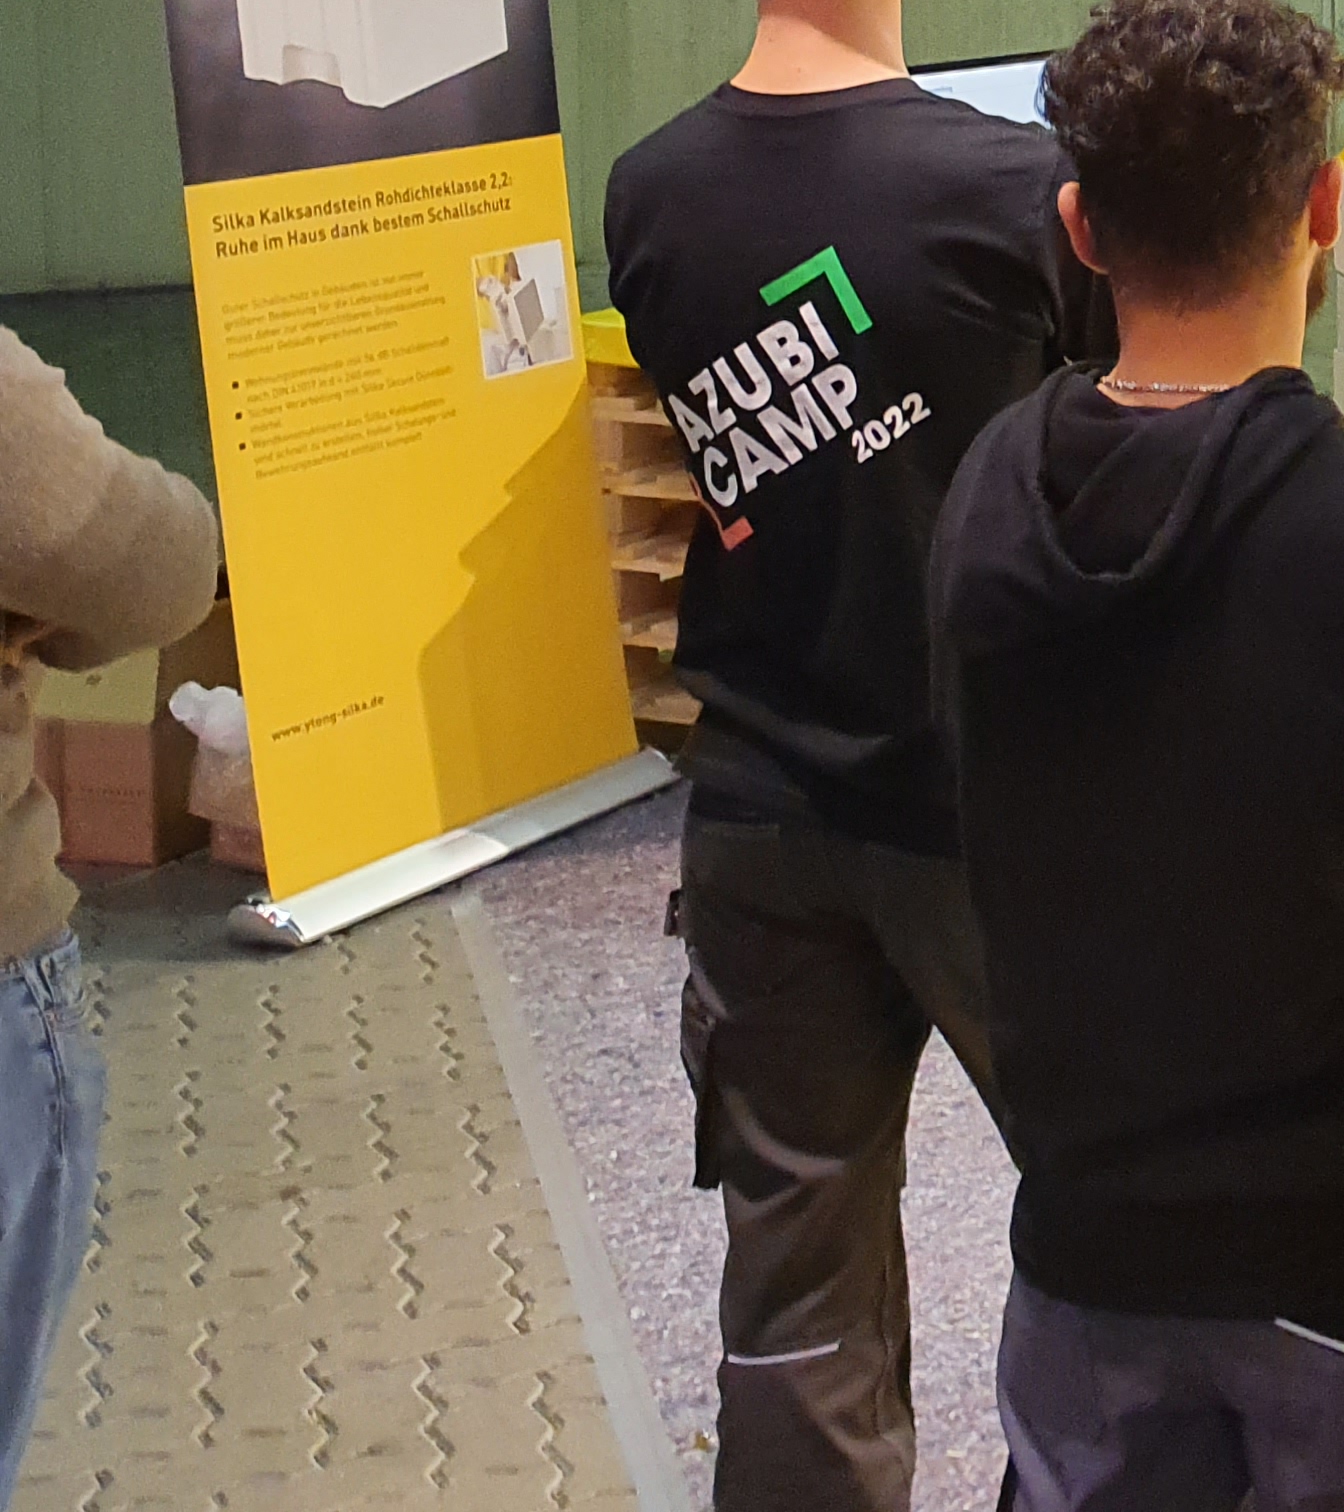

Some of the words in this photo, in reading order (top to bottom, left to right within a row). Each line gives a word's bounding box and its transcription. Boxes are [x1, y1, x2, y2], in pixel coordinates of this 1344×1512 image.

[212, 212, 255, 233] Silka
[259, 195, 372, 225] Kalksandstein
[375, 178, 487, 207] Rohdichteklasse
[215, 238, 259, 258] Ruhe
[263, 234, 283, 251] im
[287, 228, 327, 247] Haus
[330, 219, 369, 239] dank
[373, 212, 425, 233] bestem
[427, 197, 511, 224] Schallschutz
[668, 301, 840, 453] AZUBI
[703, 363, 857, 507] CAMP
[851, 392, 931, 464] 2022
[271, 695, 384, 742] www.ytong-silka.de
